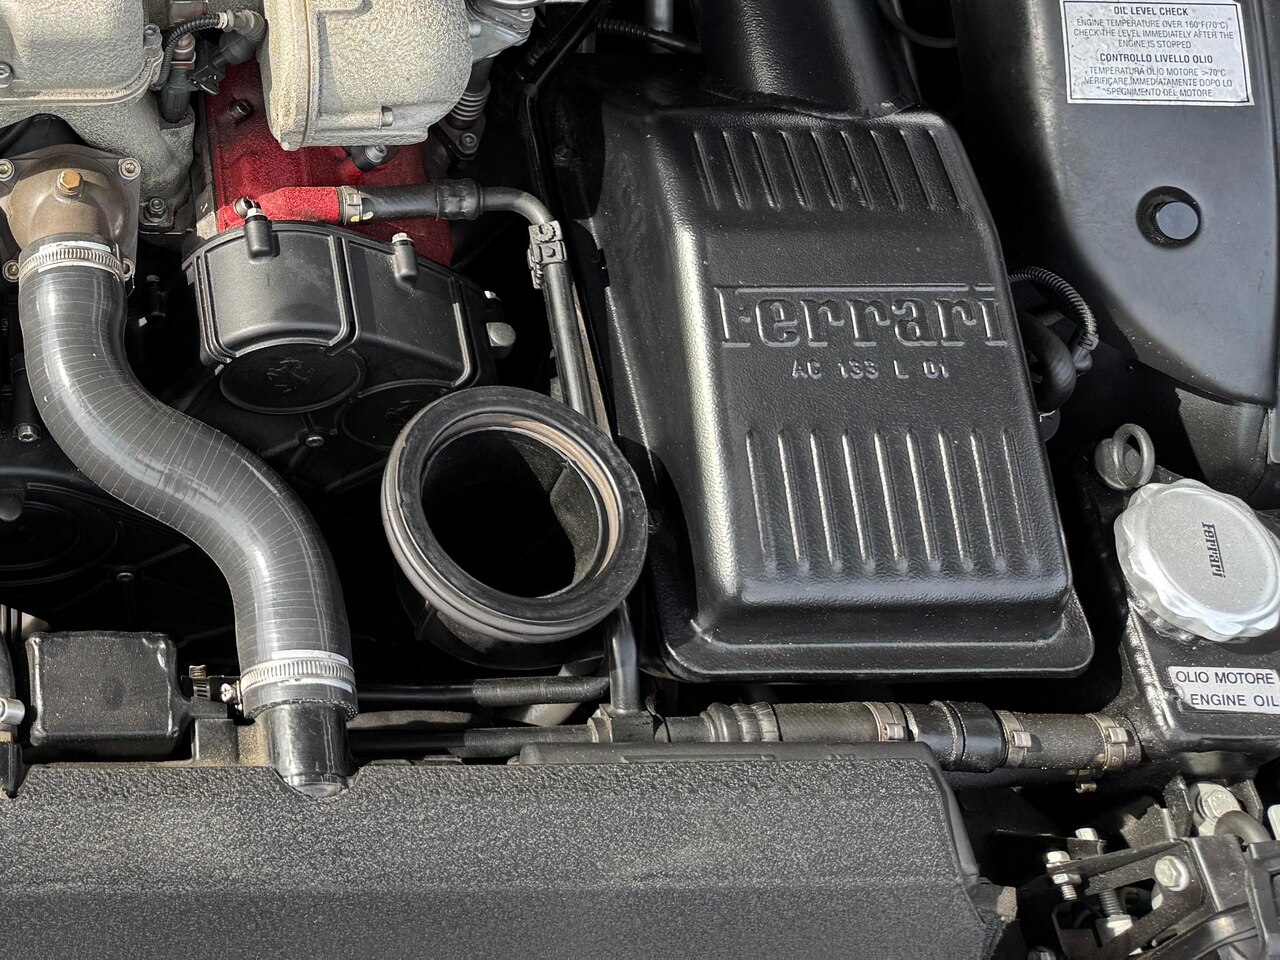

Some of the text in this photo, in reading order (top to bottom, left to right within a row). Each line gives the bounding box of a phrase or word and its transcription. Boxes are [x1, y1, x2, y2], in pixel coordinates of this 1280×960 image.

[1113, 7, 1189, 16] OIL LEVEL CHECK
[1076, 19, 1104, 27] ENGINE
[1106, 19, 1161, 28] TEMPERATURE
[1162, 20, 1182, 29] OVER
[1073, 29, 1234, 39] CHECK THE LEVEL IMMEDIATELY AFTER THE
[1118, 40, 1192, 49] ENGINE IS STOPPED
[1100, 53, 1213, 64] CONTROLLO LIVELLO OLIO
[1089, 66, 1145, 75] TEMPERATURA
[1146, 68, 1165, 76] OLIO
[1166, 68, 1199, 76] MOTORE
[1084, 77, 1232, 87] VERIFICARE IMMEDIATAMENTE DOPO LO
[1106, 88, 1212, 98] SPEGNIMENTO DEL MOTORE
[714, 284, 1008, 348] Ferrari
[791, 359, 950, 379] AC 133 L 01
[1201, 521, 1226, 578] Ferrari
[1176, 670, 1275, 684] OLIO MOTORE
[1190, 693, 1280, 707] ENGINE OIL
